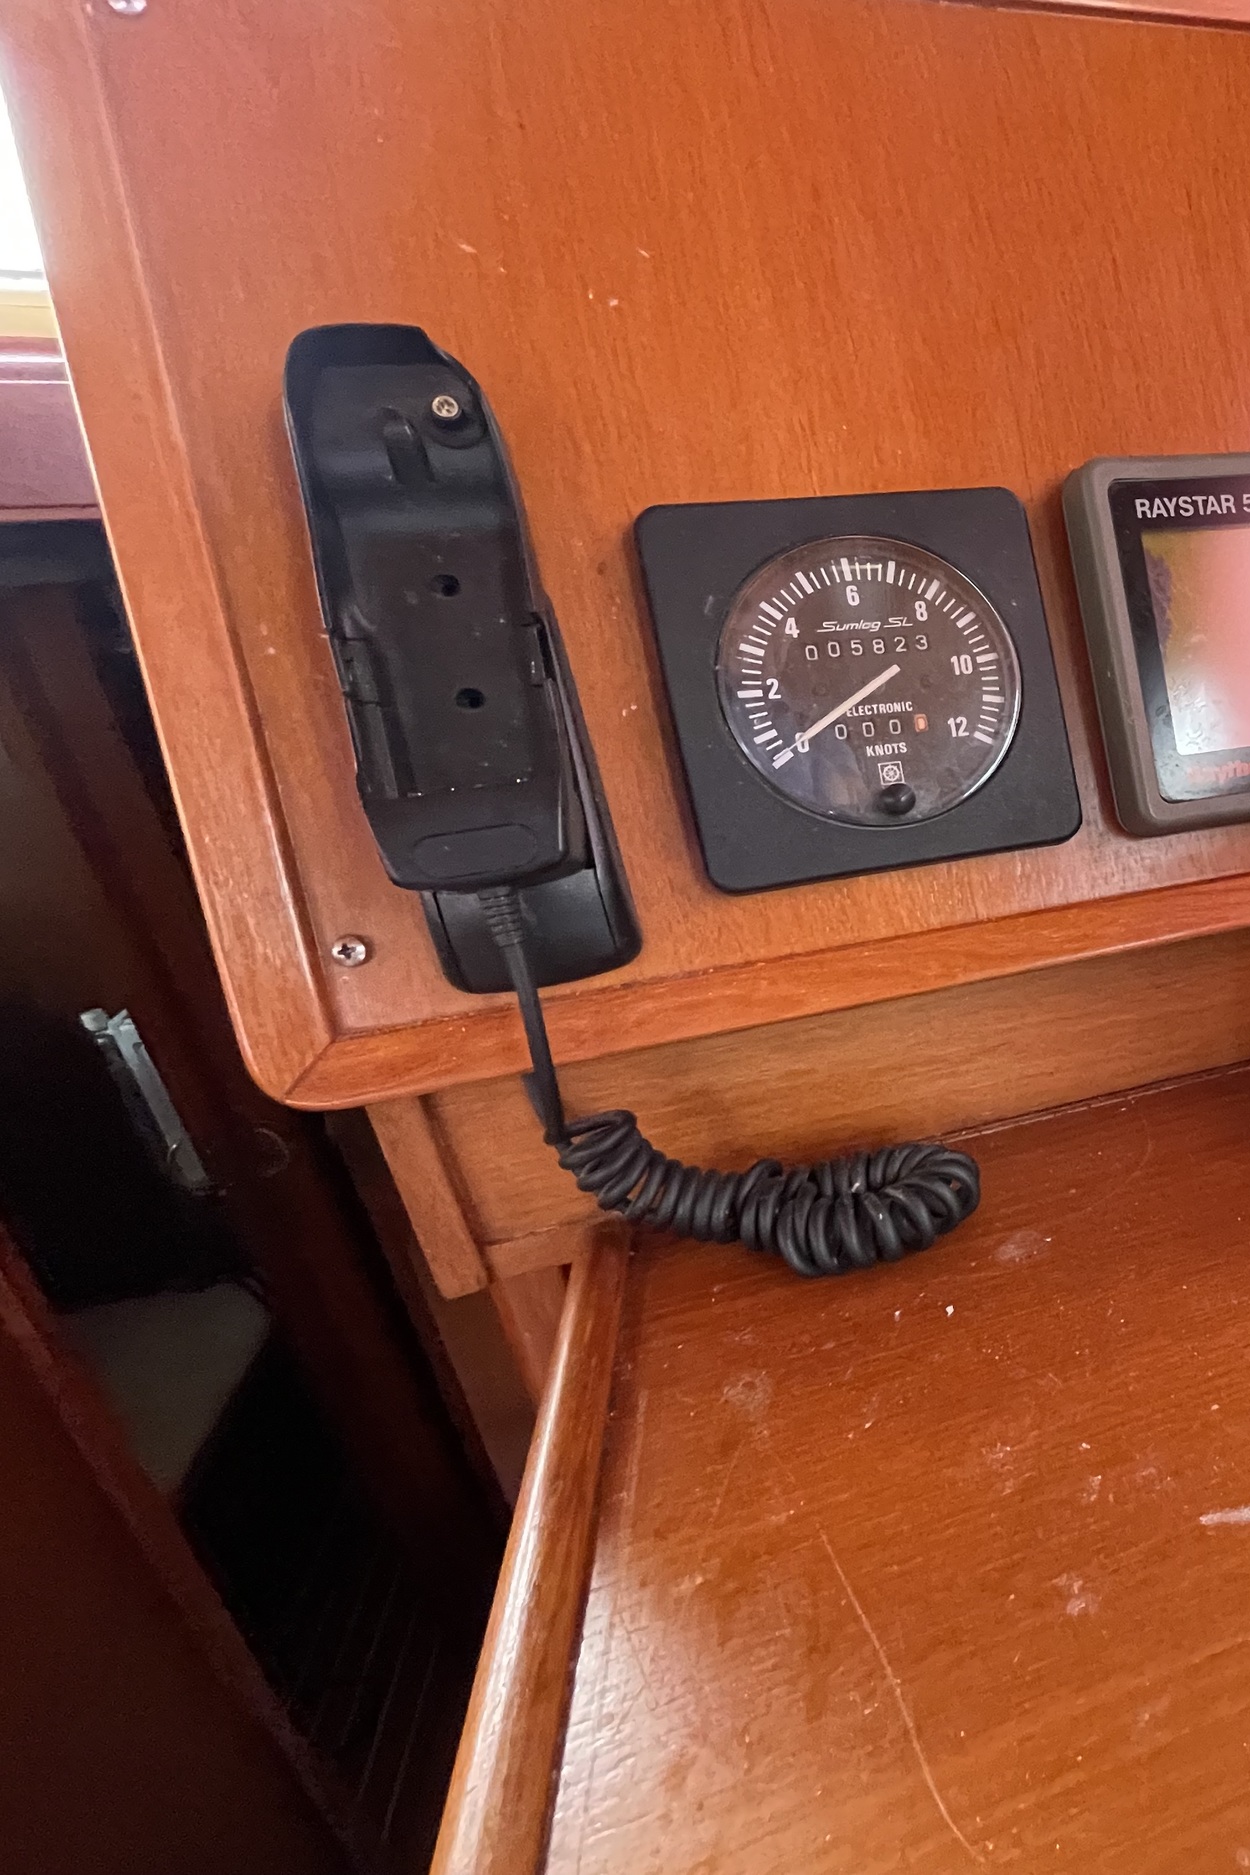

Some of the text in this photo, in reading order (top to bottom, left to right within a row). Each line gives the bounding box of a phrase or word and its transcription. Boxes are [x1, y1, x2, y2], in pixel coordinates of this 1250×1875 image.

[1135, 494, 1236, 519] RAYSTAR
[846, 586, 860, 606] 6
[914, 601, 929, 622] 8
[784, 617, 800, 638] 4
[950, 654, 974, 676] 10
[766, 678, 782, 699] 2
[846, 701, 914, 718] ELECTRONIC
[947, 717, 970, 738] 12
[865, 742, 908, 757] KNOTS
